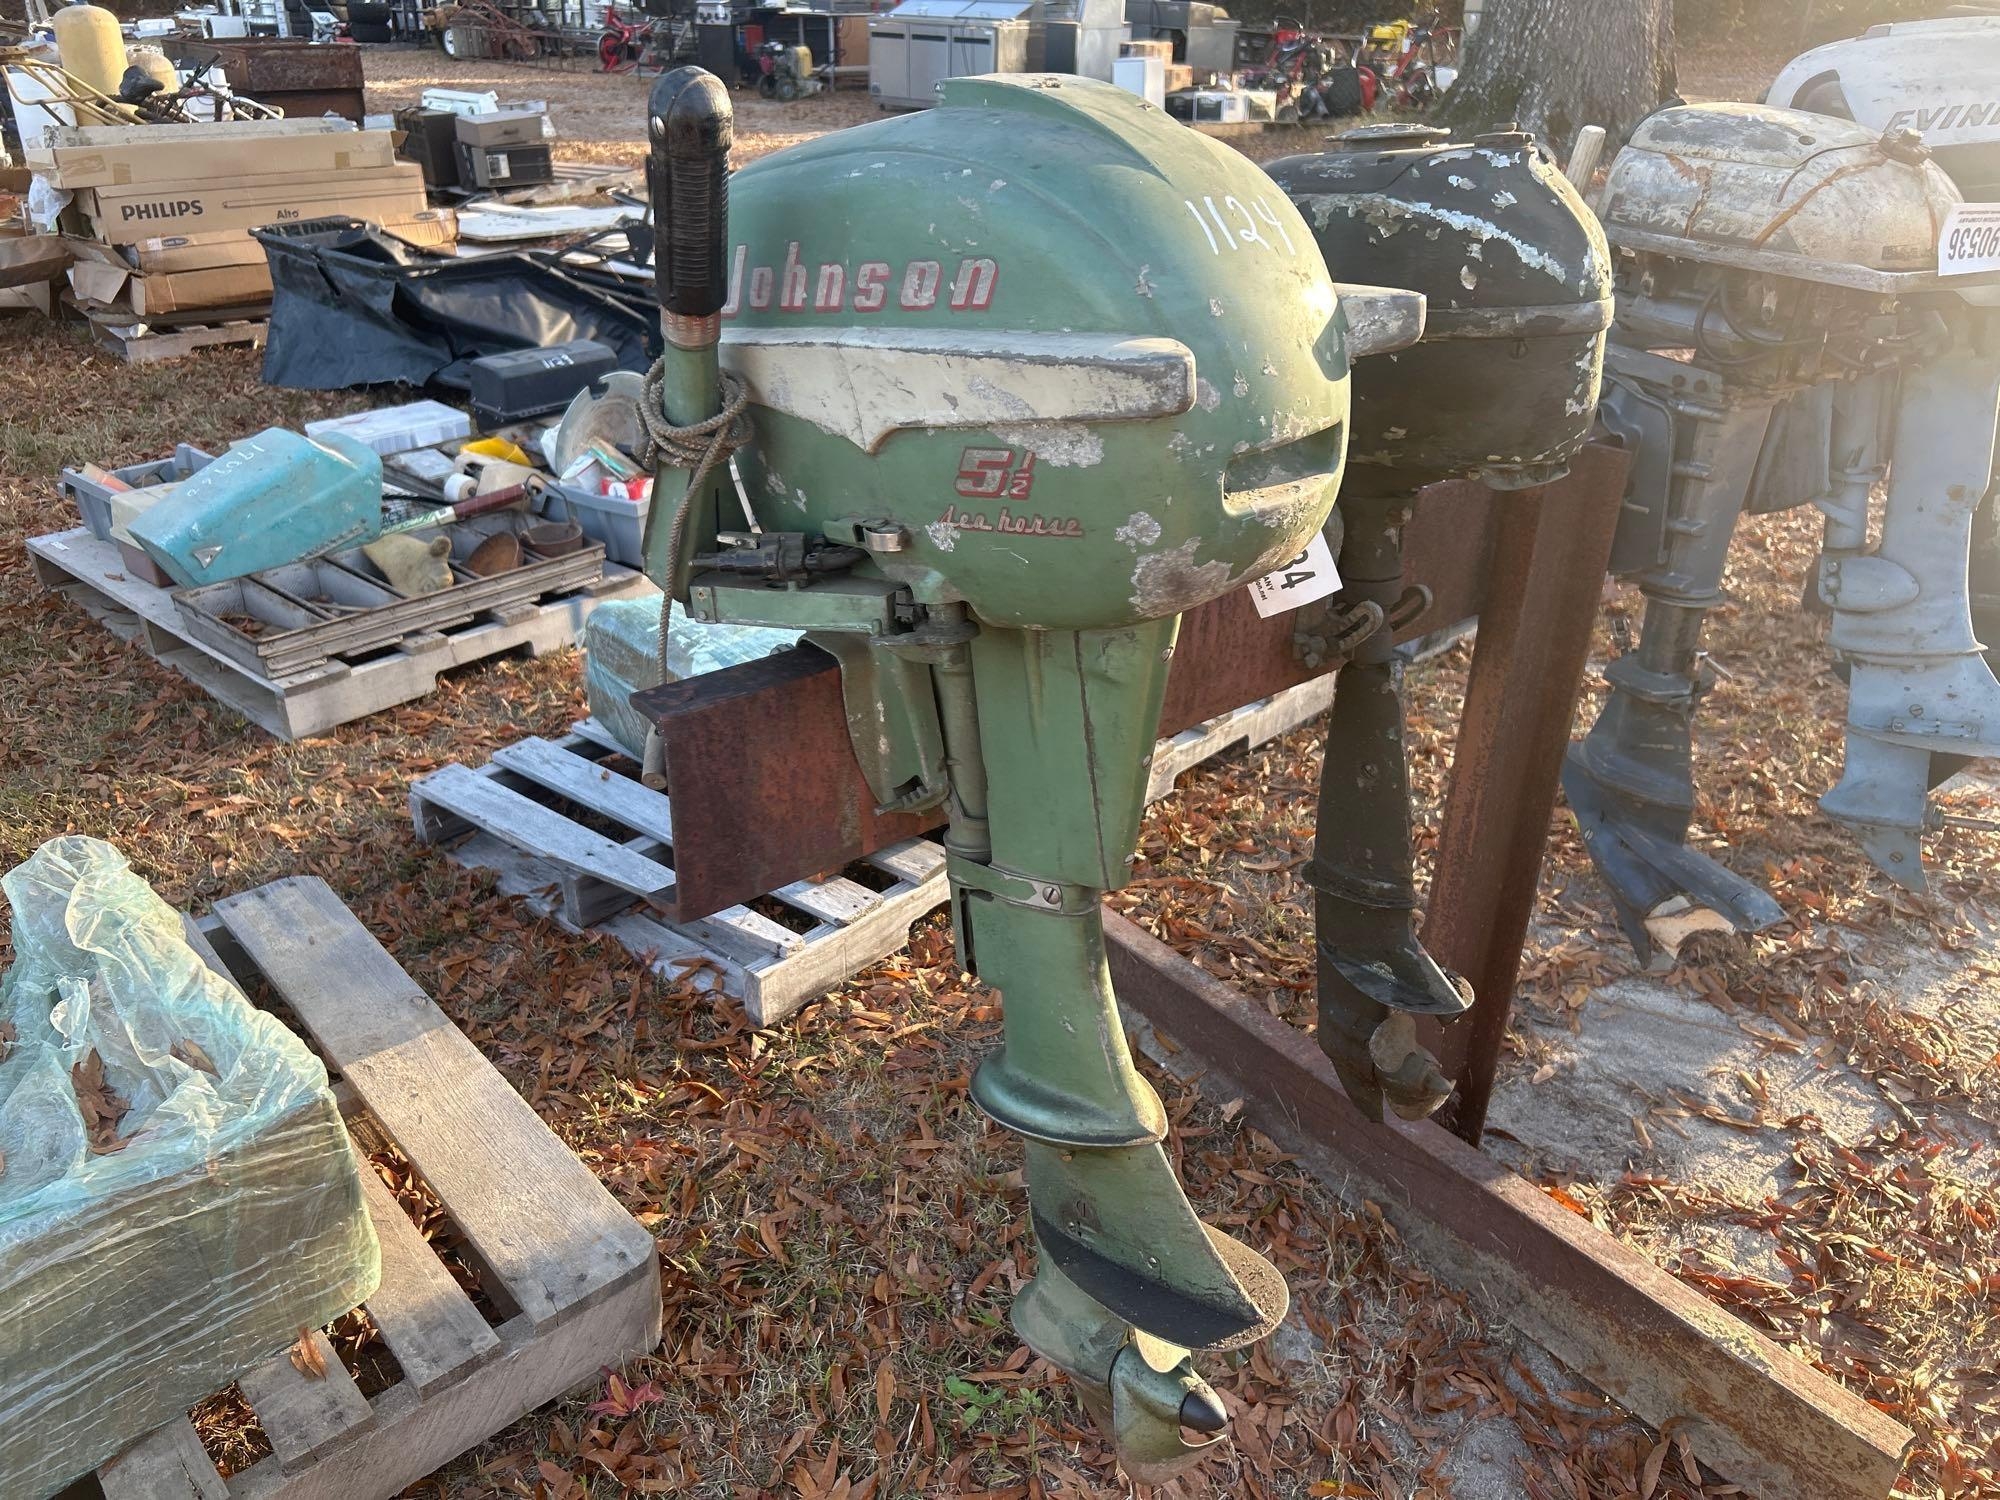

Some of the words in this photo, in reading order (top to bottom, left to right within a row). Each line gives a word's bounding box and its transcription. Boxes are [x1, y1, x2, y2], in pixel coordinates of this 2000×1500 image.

[121, 200, 203, 221] PHILIPS
[277, 209, 299, 219] Alto
[1184, 195, 1296, 256] 1124
[1947, 227, 2000, 261] 90536
[721, 241, 999, 319] Johnson
